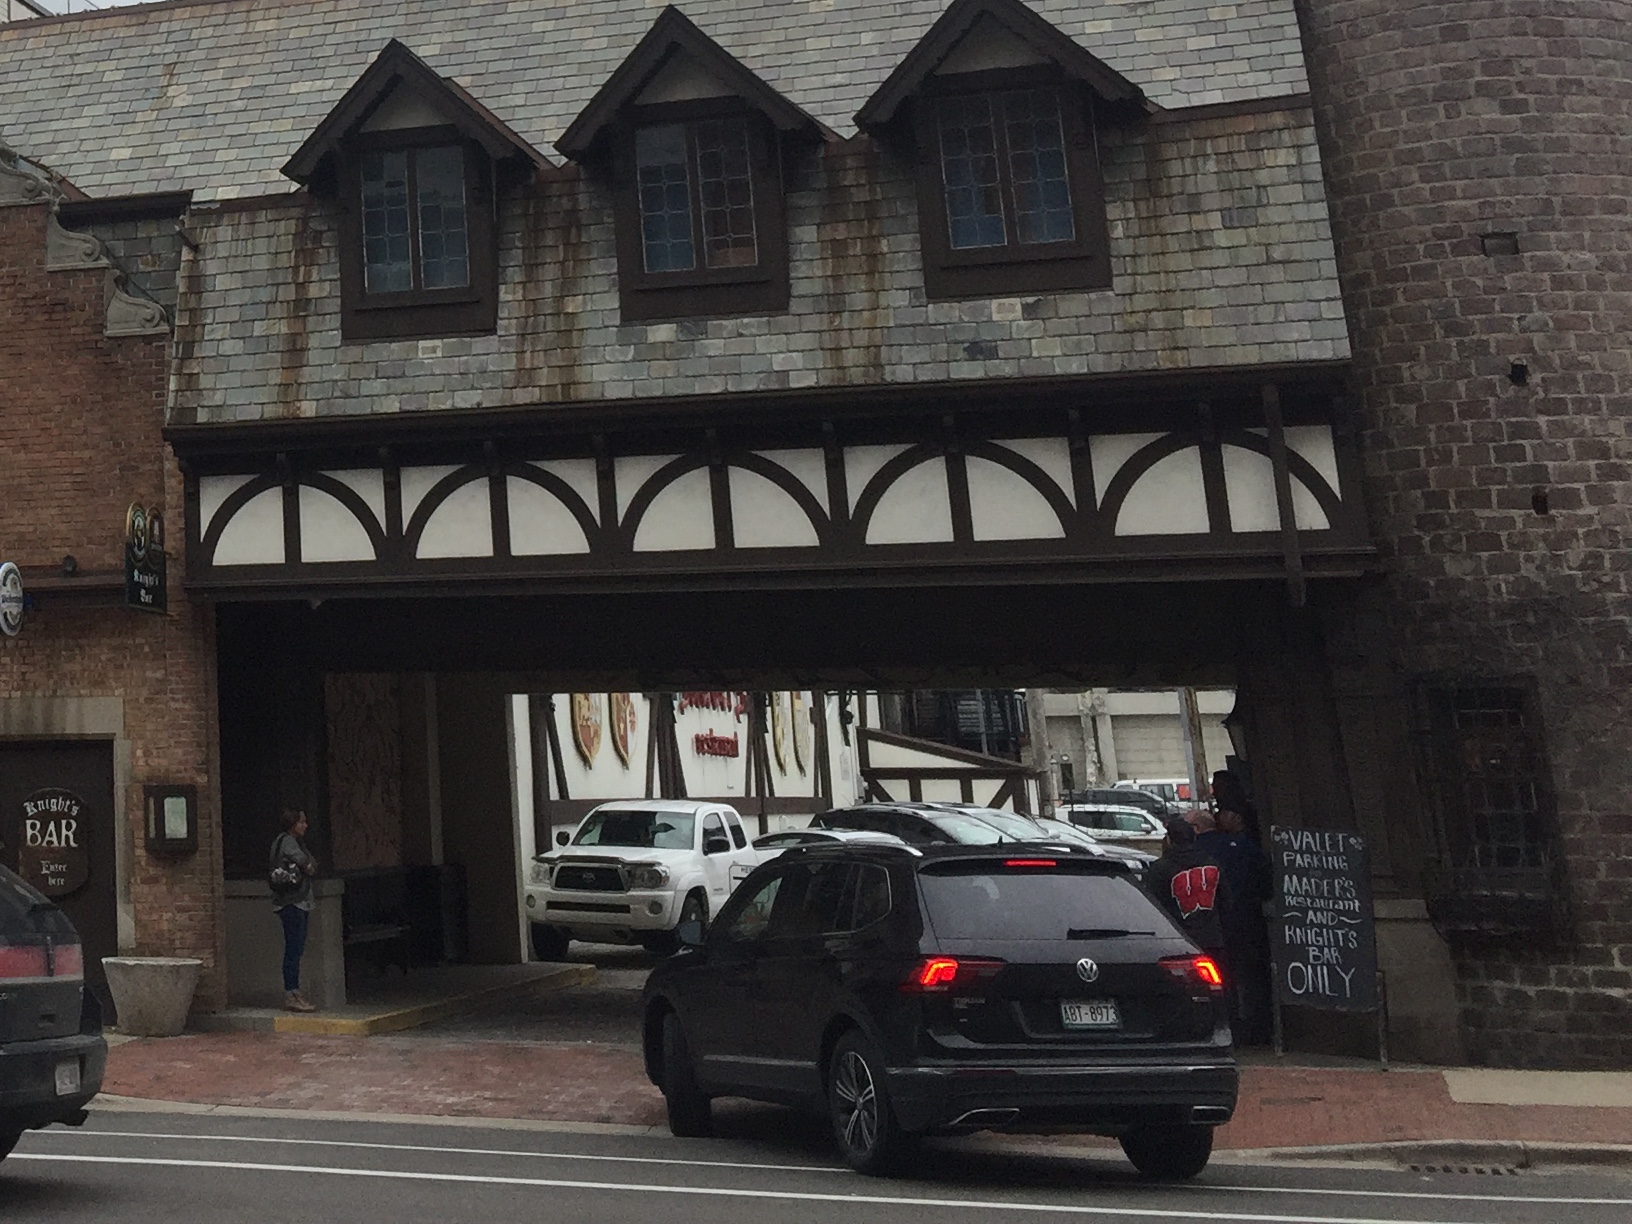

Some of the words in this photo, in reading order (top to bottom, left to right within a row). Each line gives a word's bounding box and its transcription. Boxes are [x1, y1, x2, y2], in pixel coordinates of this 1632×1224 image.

[23, 796, 80, 817] Knight's
[25, 819, 79, 848] BAR
[1288, 829, 1348, 853] VALET
[40, 860, 68, 875] Enter
[1283, 851, 1348, 871] PARKING
[48, 876, 65, 886] here
[1283, 874, 1356, 899] MADER'S
[1284, 895, 1361, 913] Restaurant
[1306, 909, 1339, 926] AND
[1305, 946, 1342, 965] BAR
[1288, 961, 1356, 998] ONLY
